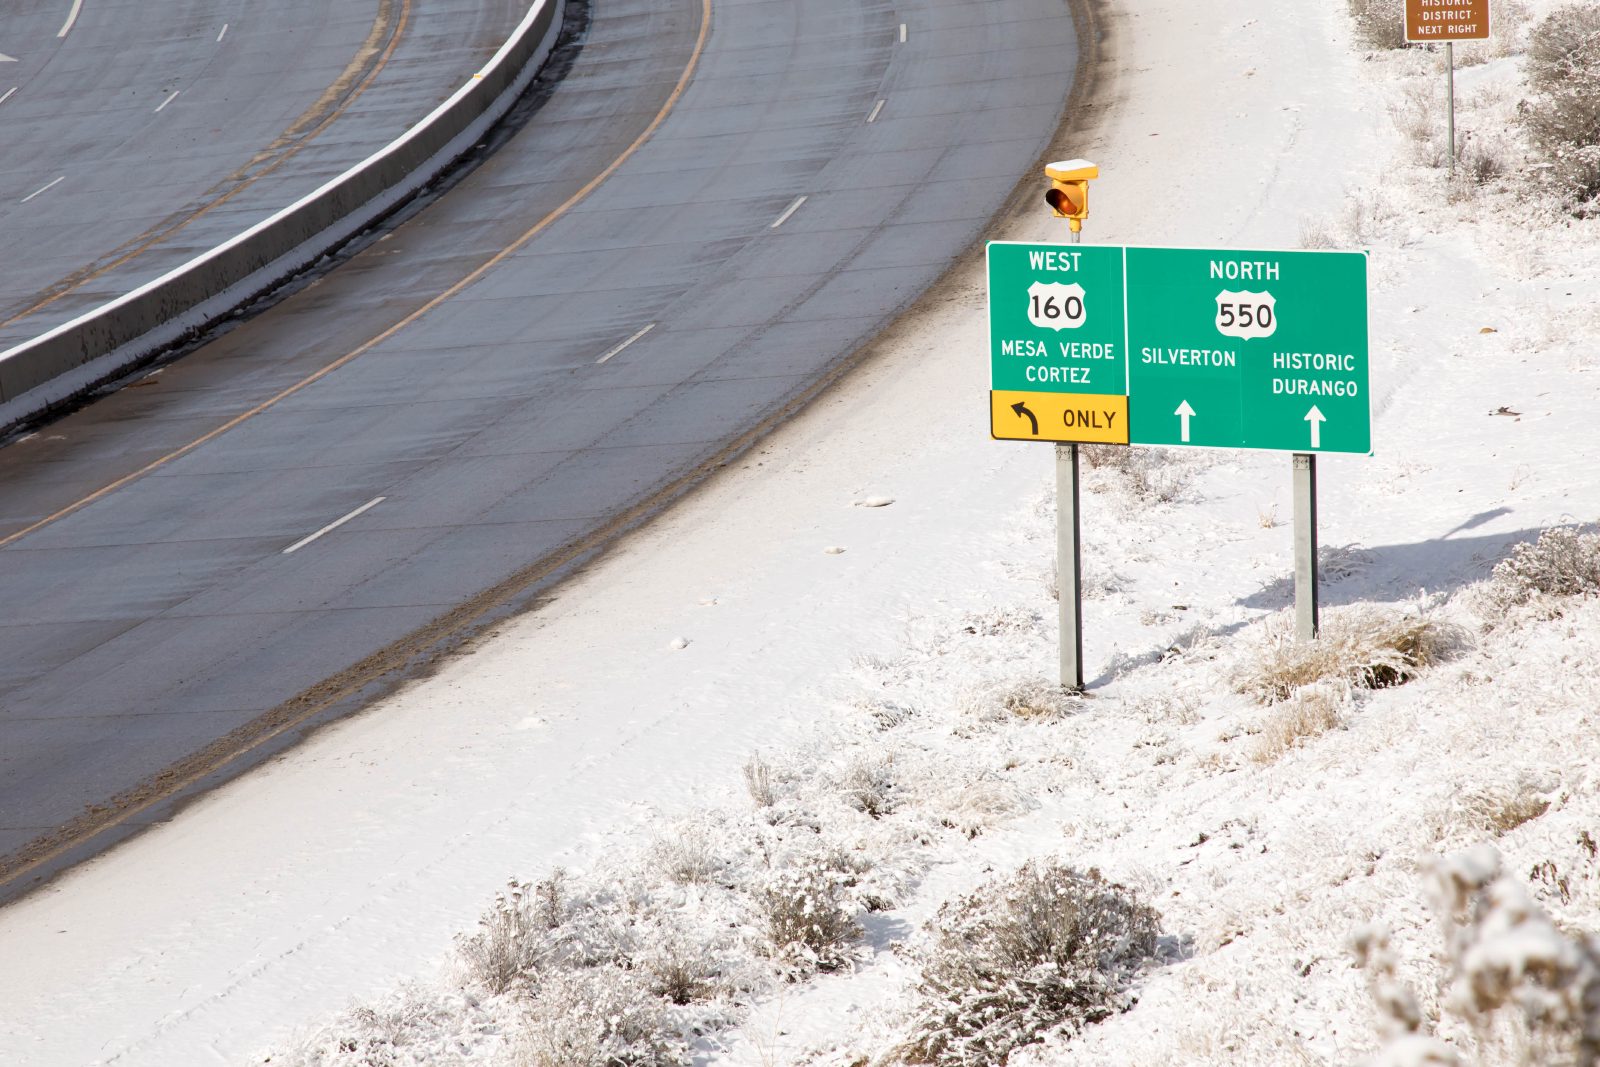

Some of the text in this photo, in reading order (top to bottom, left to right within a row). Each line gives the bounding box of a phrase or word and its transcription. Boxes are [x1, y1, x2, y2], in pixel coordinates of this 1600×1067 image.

[1423, 10, 1471, 20] DISTRICT
[1418, 24, 1477, 34] NEXT RIGHT
[1029, 251, 1081, 272] WEST
[1210, 261, 1280, 281] NORTH
[1031, 295, 1082, 320] 160
[1220, 303, 1272, 328] 550
[1001, 340, 1114, 360] MESA VERDE
[1141, 348, 1236, 367] SILVERTON
[1273, 353, 1355, 371] HISTORIC
[1026, 366, 1091, 383] CORTEZ
[1272, 379, 1358, 397] DURANGO
[1063, 409, 1116, 429] ONLY
